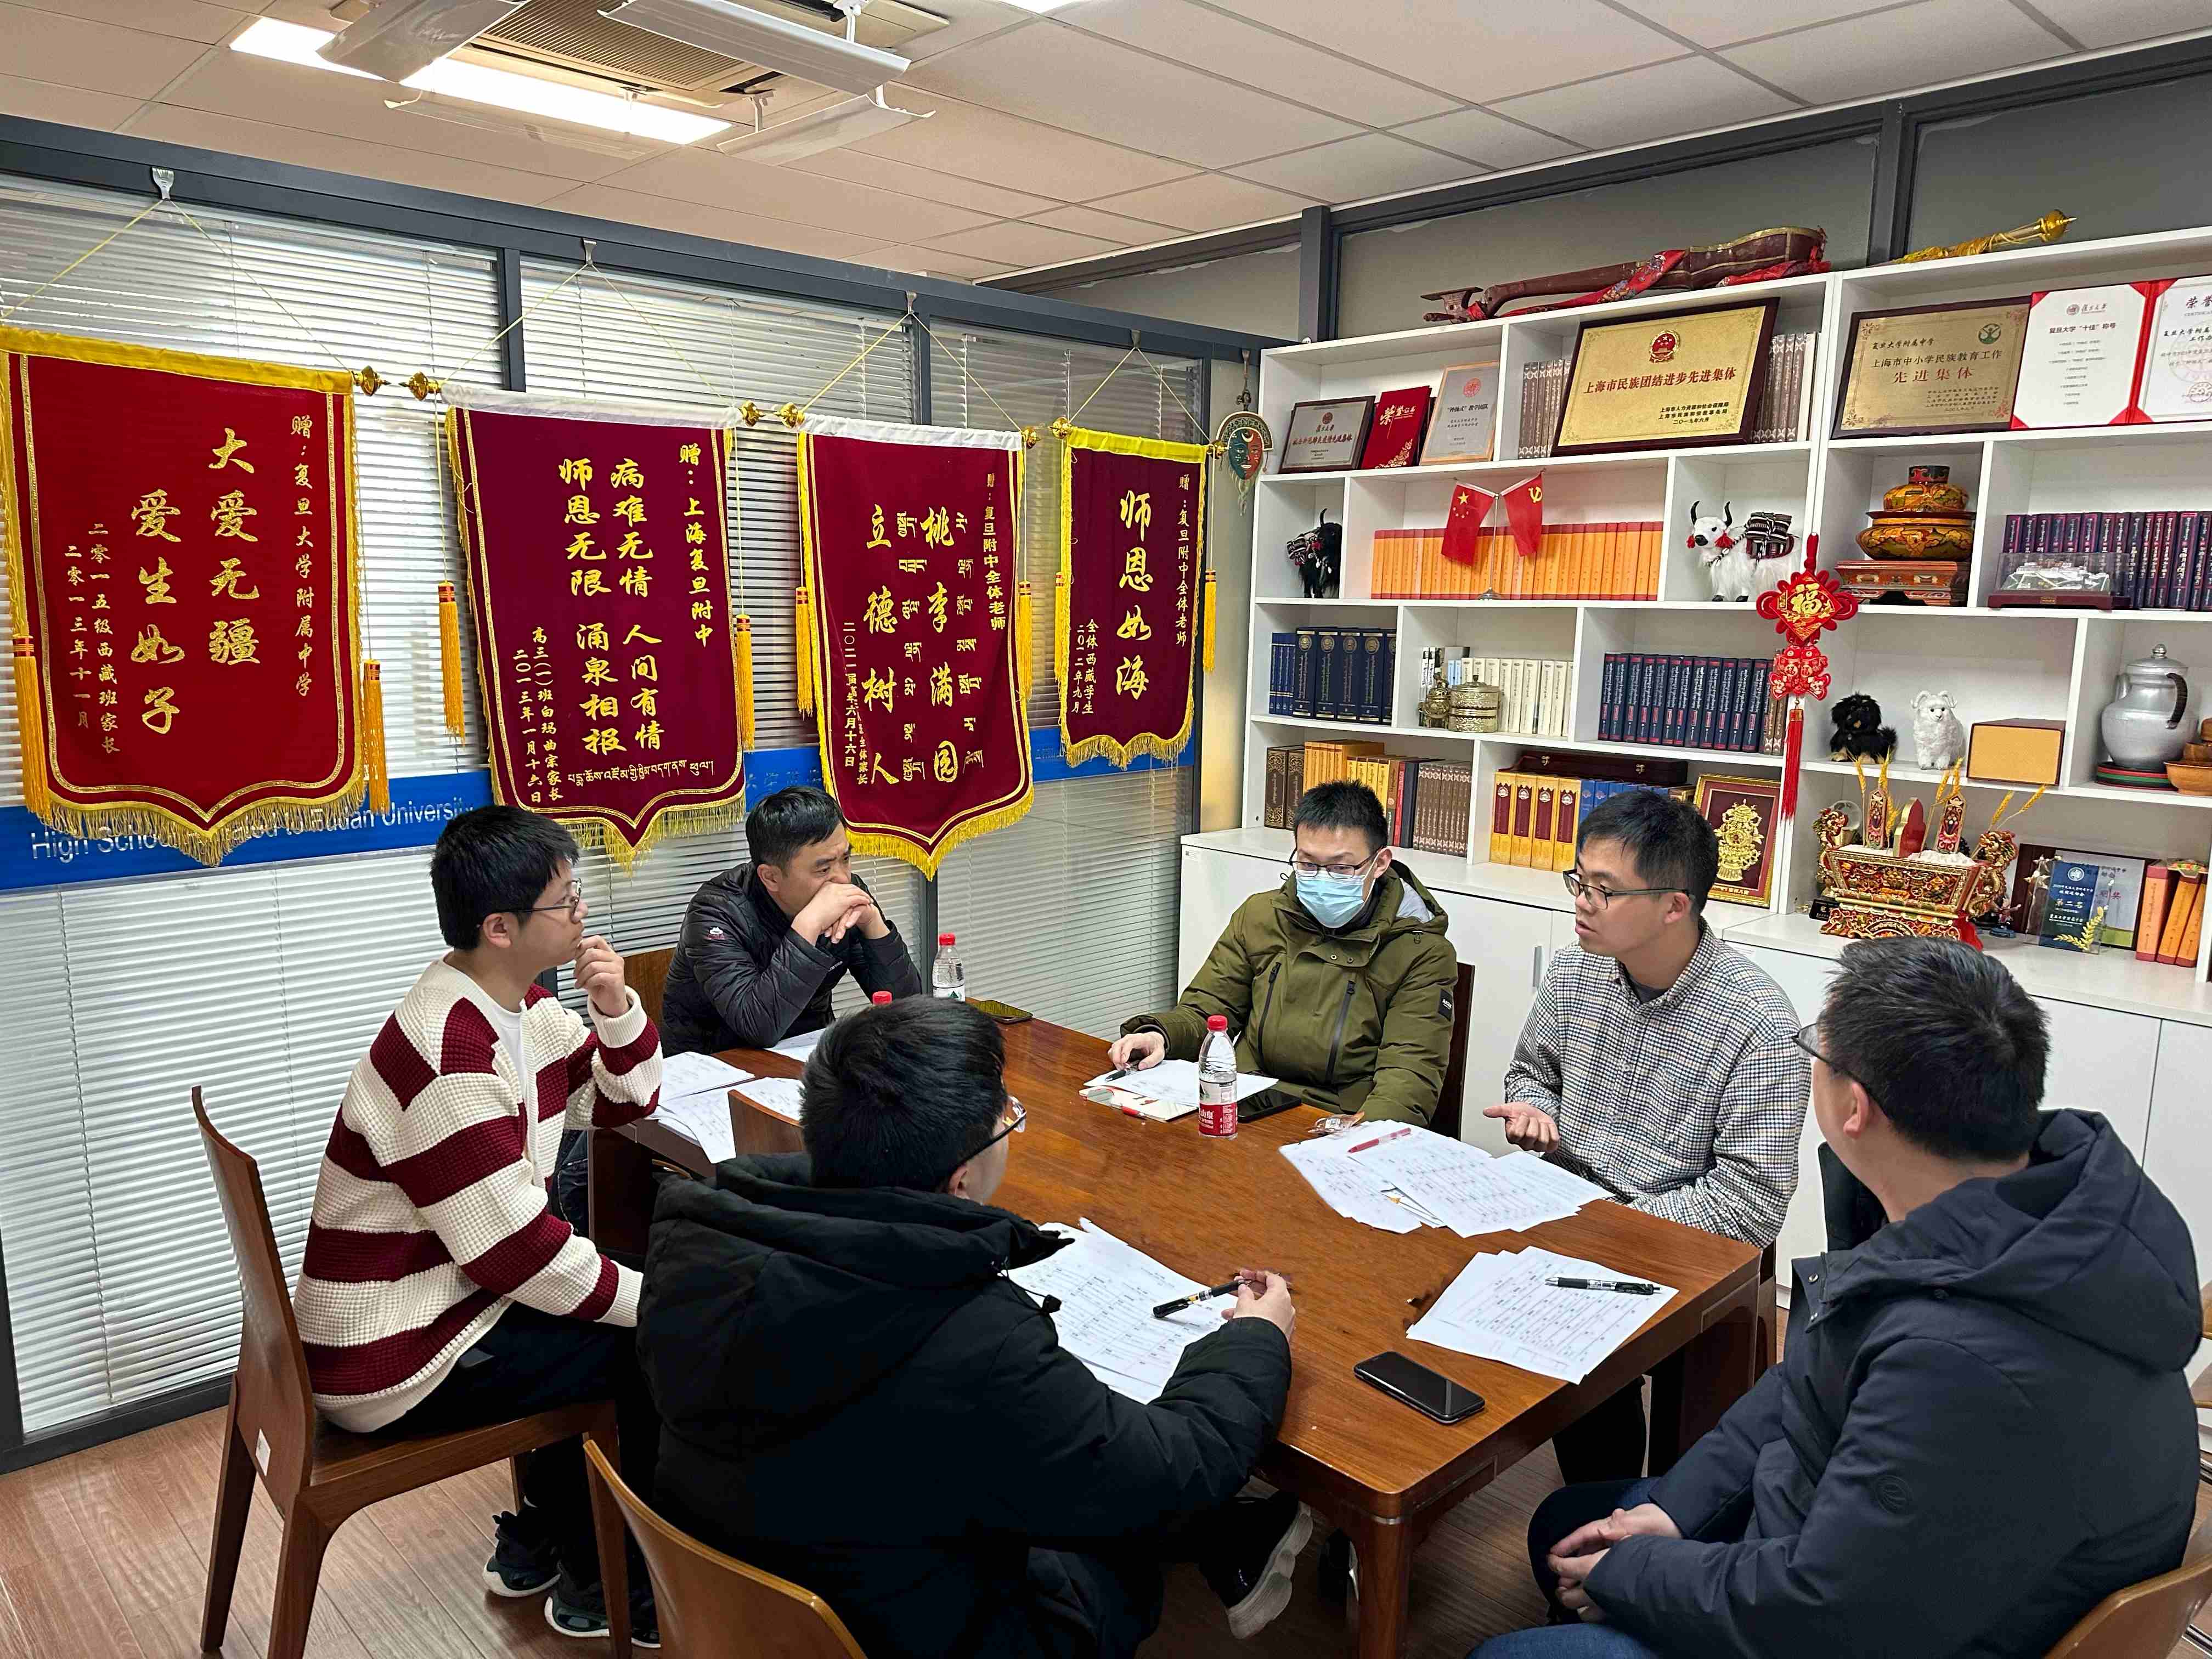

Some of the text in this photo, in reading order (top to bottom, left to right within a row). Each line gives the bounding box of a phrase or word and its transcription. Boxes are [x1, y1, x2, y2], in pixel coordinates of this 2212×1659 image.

[1380, 404, 1417, 425] 荣誉证书
[1583, 367, 1736, 394] 上海市民族团结进步先进集体
[1871, 350, 2002, 368] 上海市中小学民族教育工作
[1872, 337, 1935, 350] 复旦大学附属中学
[1893, 366, 1973, 384] 先进集体
[64, 545, 92, 729] 二零一三年十一月
[88, 523, 121, 753] 二零一五级西藏班家长
[129, 489, 185, 735] 爱生如子
[208, 428, 262, 666] 大爱无疆
[558, 459, 628, 755] 师恩无限 涌泉相报
[610, 459, 665, 751] 病难无情 人间有情
[1116, 489, 1153, 699] 师恩如海
[1791, 583, 1822, 615] 福
[861, 504, 900, 786] 立德树人
[920, 506, 958, 783] 桃李满园
[1082, 619, 1099, 714] 全体西藏学生
[31, 828, 89, 863] High
